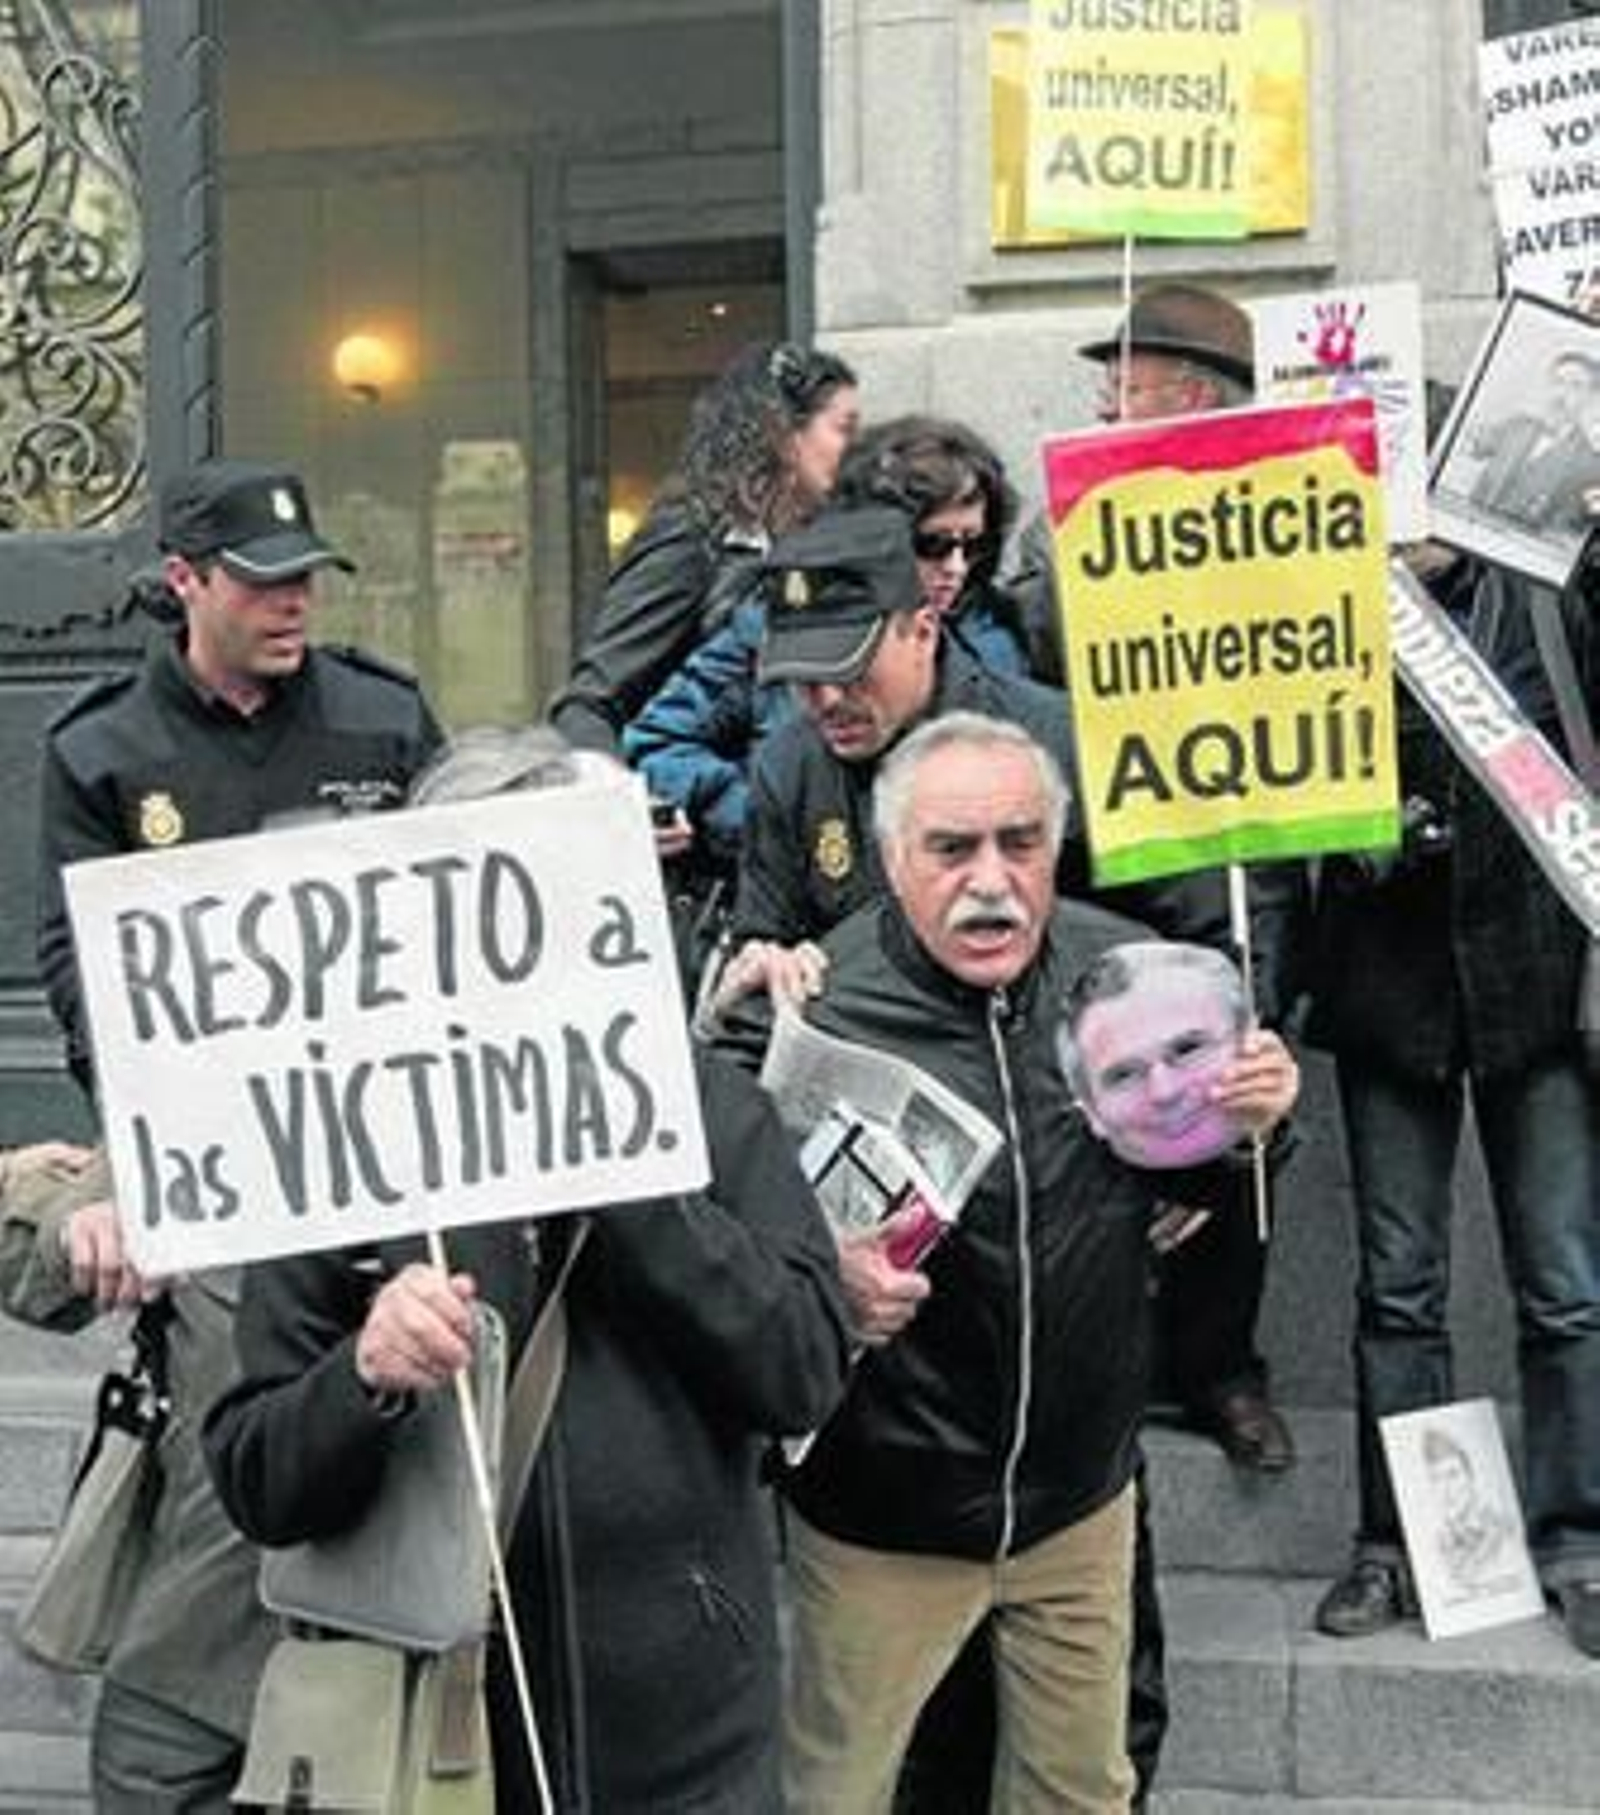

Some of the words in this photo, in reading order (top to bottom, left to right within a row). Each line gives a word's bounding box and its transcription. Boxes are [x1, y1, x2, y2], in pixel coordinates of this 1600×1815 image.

[1045, 55, 1237, 123] universal,
[1543, 112, 1600, 149] YO
[1045, 125, 1235, 191] AQUÍ!
[1081, 475, 1365, 579] Justicia
[1087, 593, 1373, 696] universal,
[1105, 690, 1376, 810] AQUÍ!
[115, 851, 544, 1043] RESPETO
[589, 896, 649, 967] a
[132, 1115, 238, 1228] las
